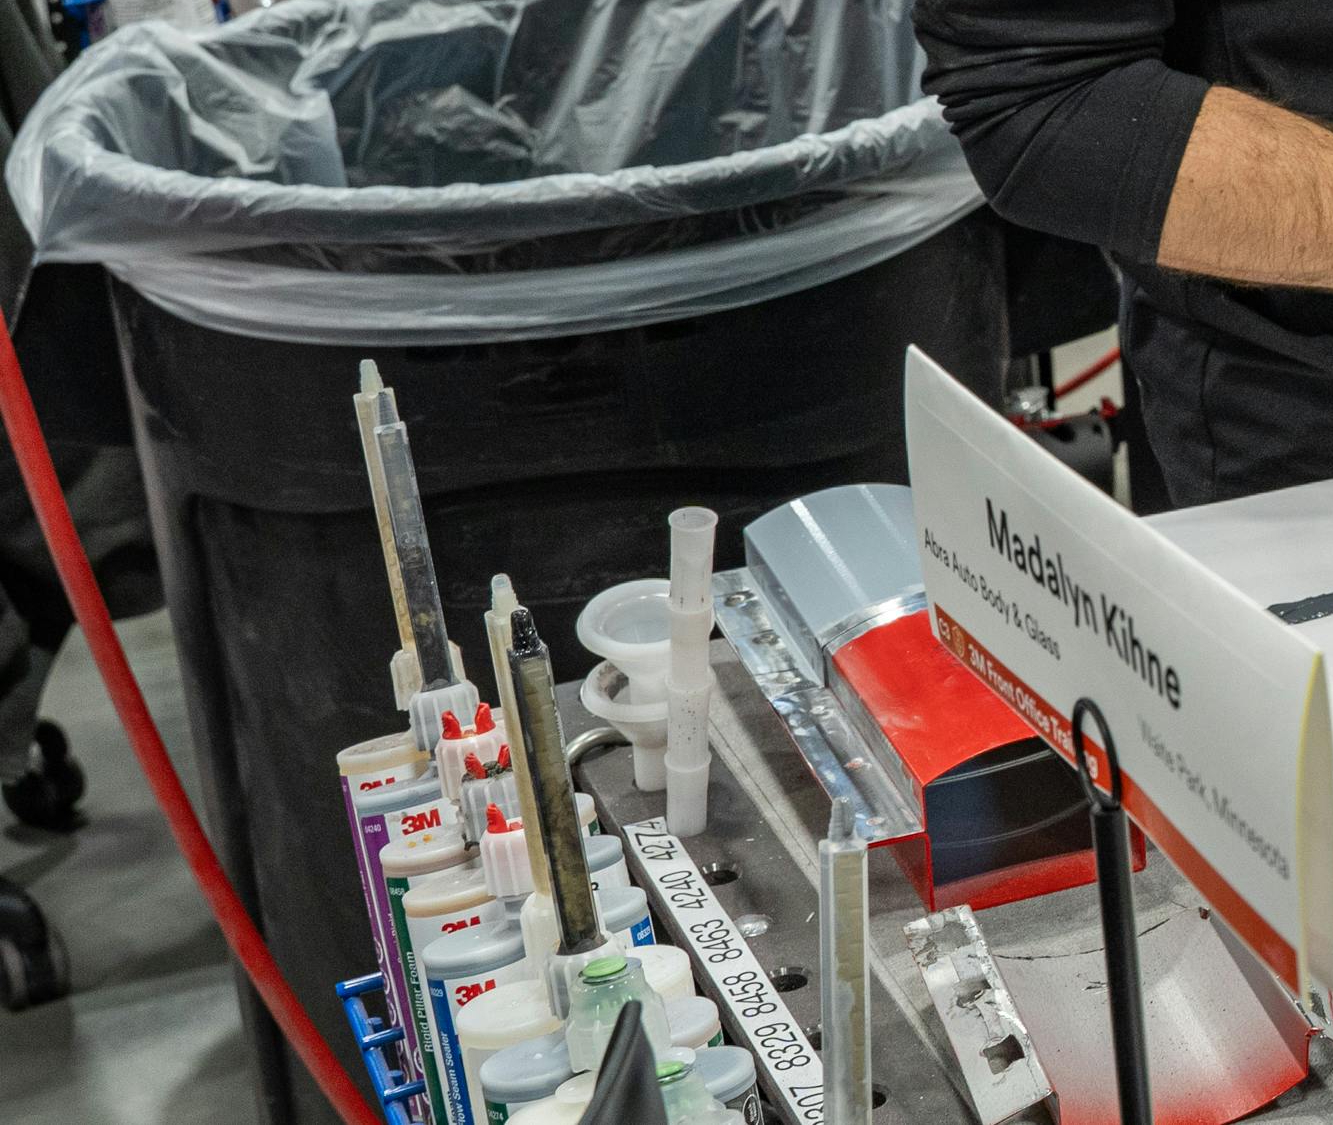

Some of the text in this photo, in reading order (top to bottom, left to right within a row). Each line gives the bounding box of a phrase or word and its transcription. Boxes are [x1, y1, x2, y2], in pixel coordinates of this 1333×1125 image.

[924, 528, 1061, 661] Abra Auto Body & Glass
[986, 497, 1181, 710] Madalyn Kihne
[968, 643, 1098, 779] 3M Front Office Traig
[401, 808, 442, 836] 3M
[406, 951, 434, 1053] Rigid Pillar Foam
[455, 979, 496, 1007] 3M
[634, 820, 824, 1125] 307 8329 8458 8463 4240 4274
[442, 1031, 457, 1067] Sealer
[449, 1065, 462, 1100] Seam
